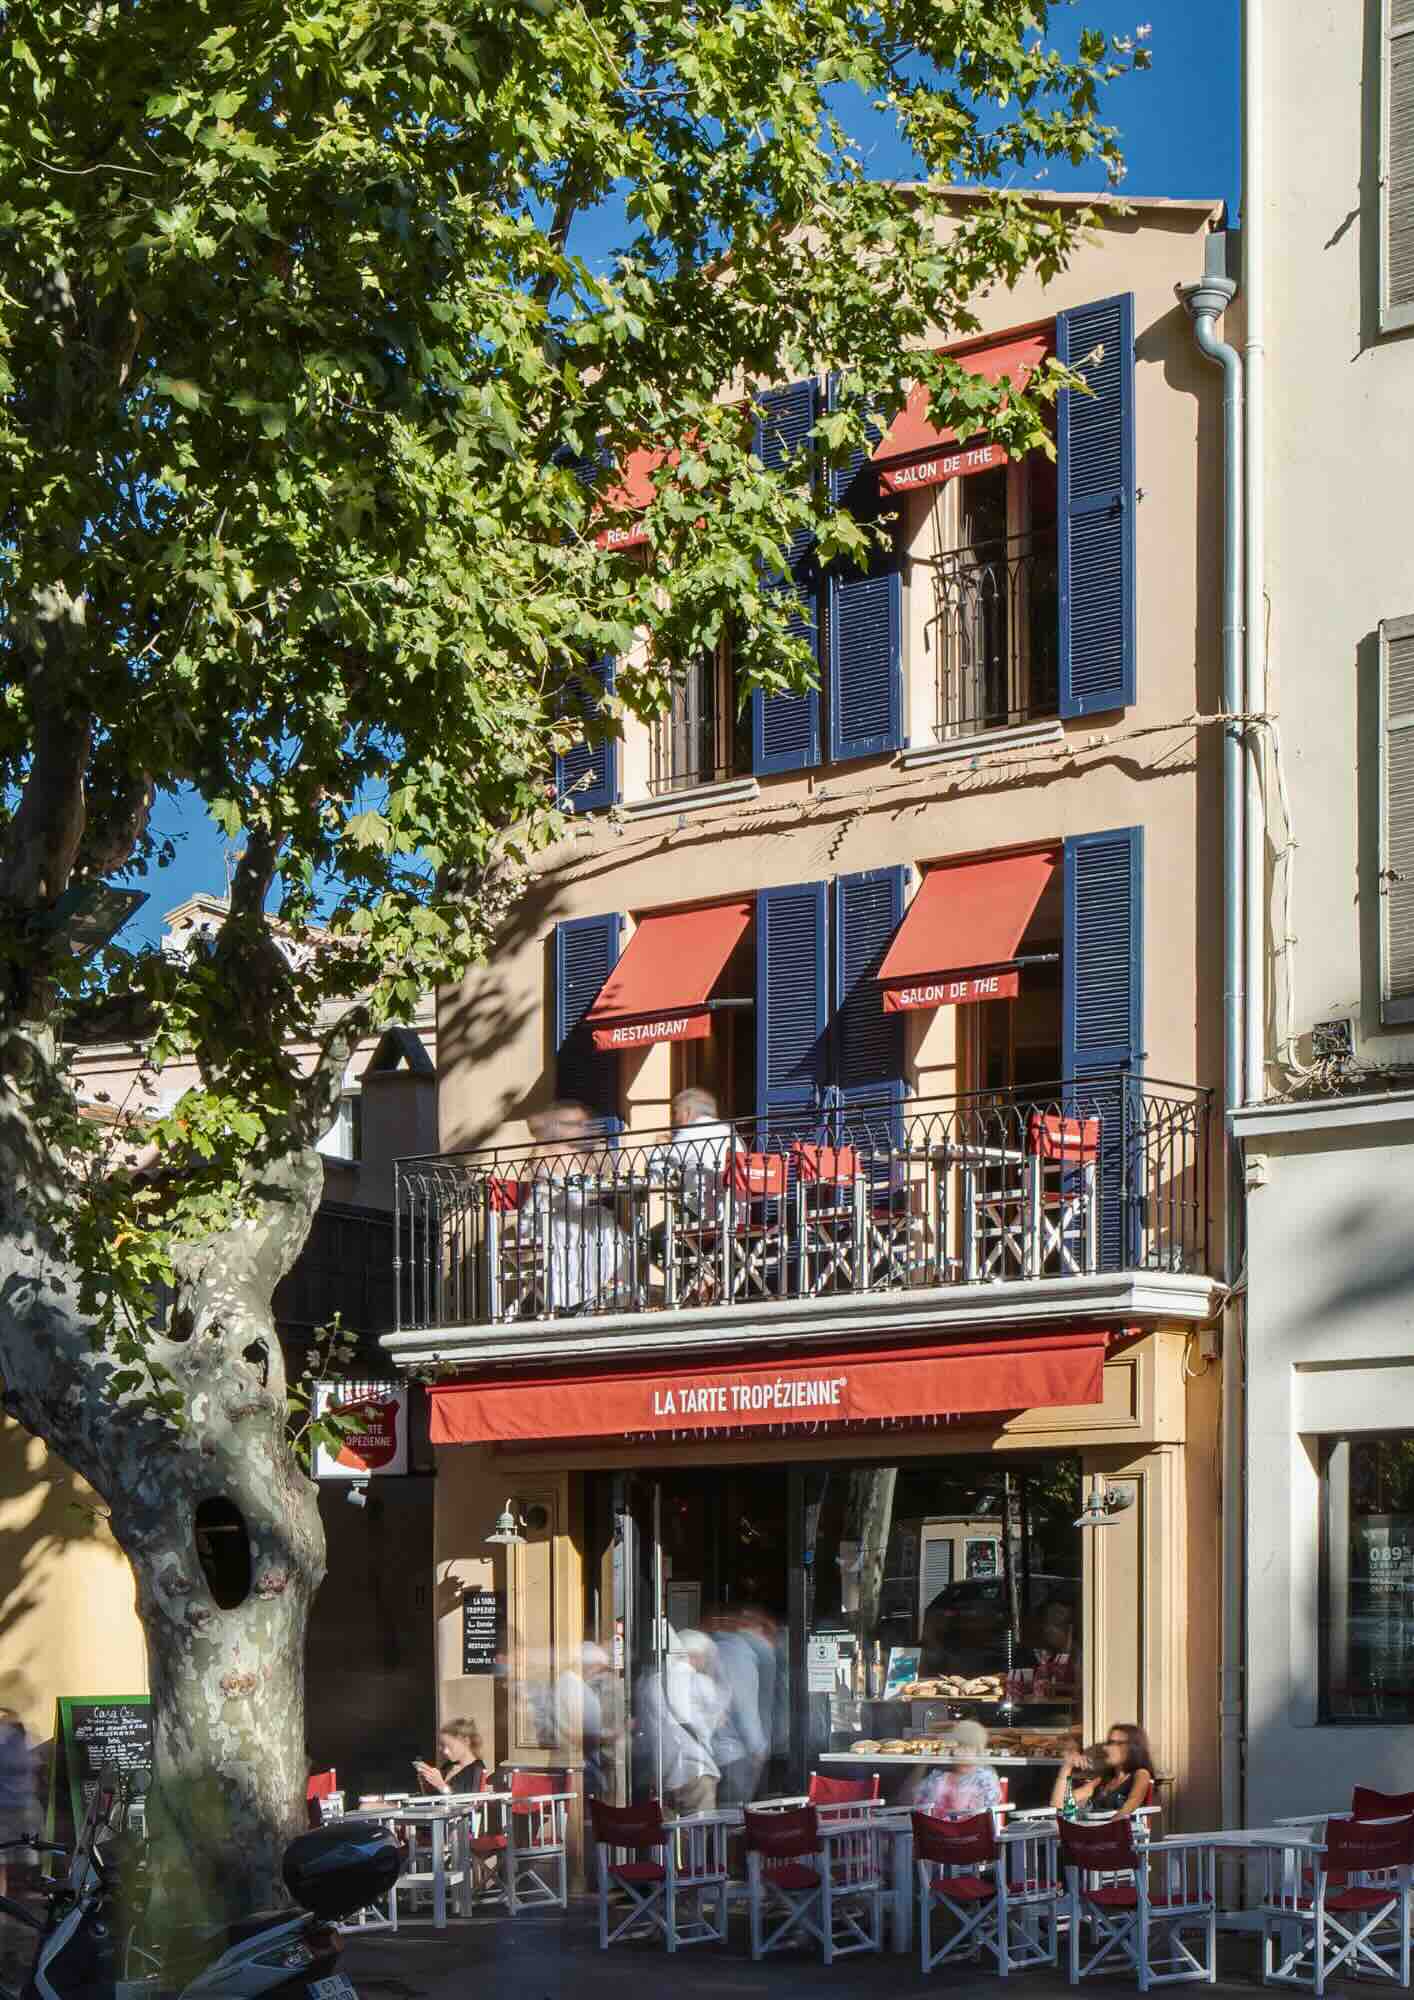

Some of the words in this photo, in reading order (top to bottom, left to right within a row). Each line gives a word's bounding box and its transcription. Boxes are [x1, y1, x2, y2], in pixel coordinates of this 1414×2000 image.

[894, 461, 937, 485] SALON
[943, 455, 961, 473] DE
[966, 446, 993, 466] THE
[900, 983, 944, 1004] SALON
[950, 982, 968, 998] DE
[973, 976, 1000, 993] THE
[612, 1019, 689, 1042] RESTAURANT
[654, 1388, 677, 1415] LA
[678, 1386, 728, 1414] TARTE
